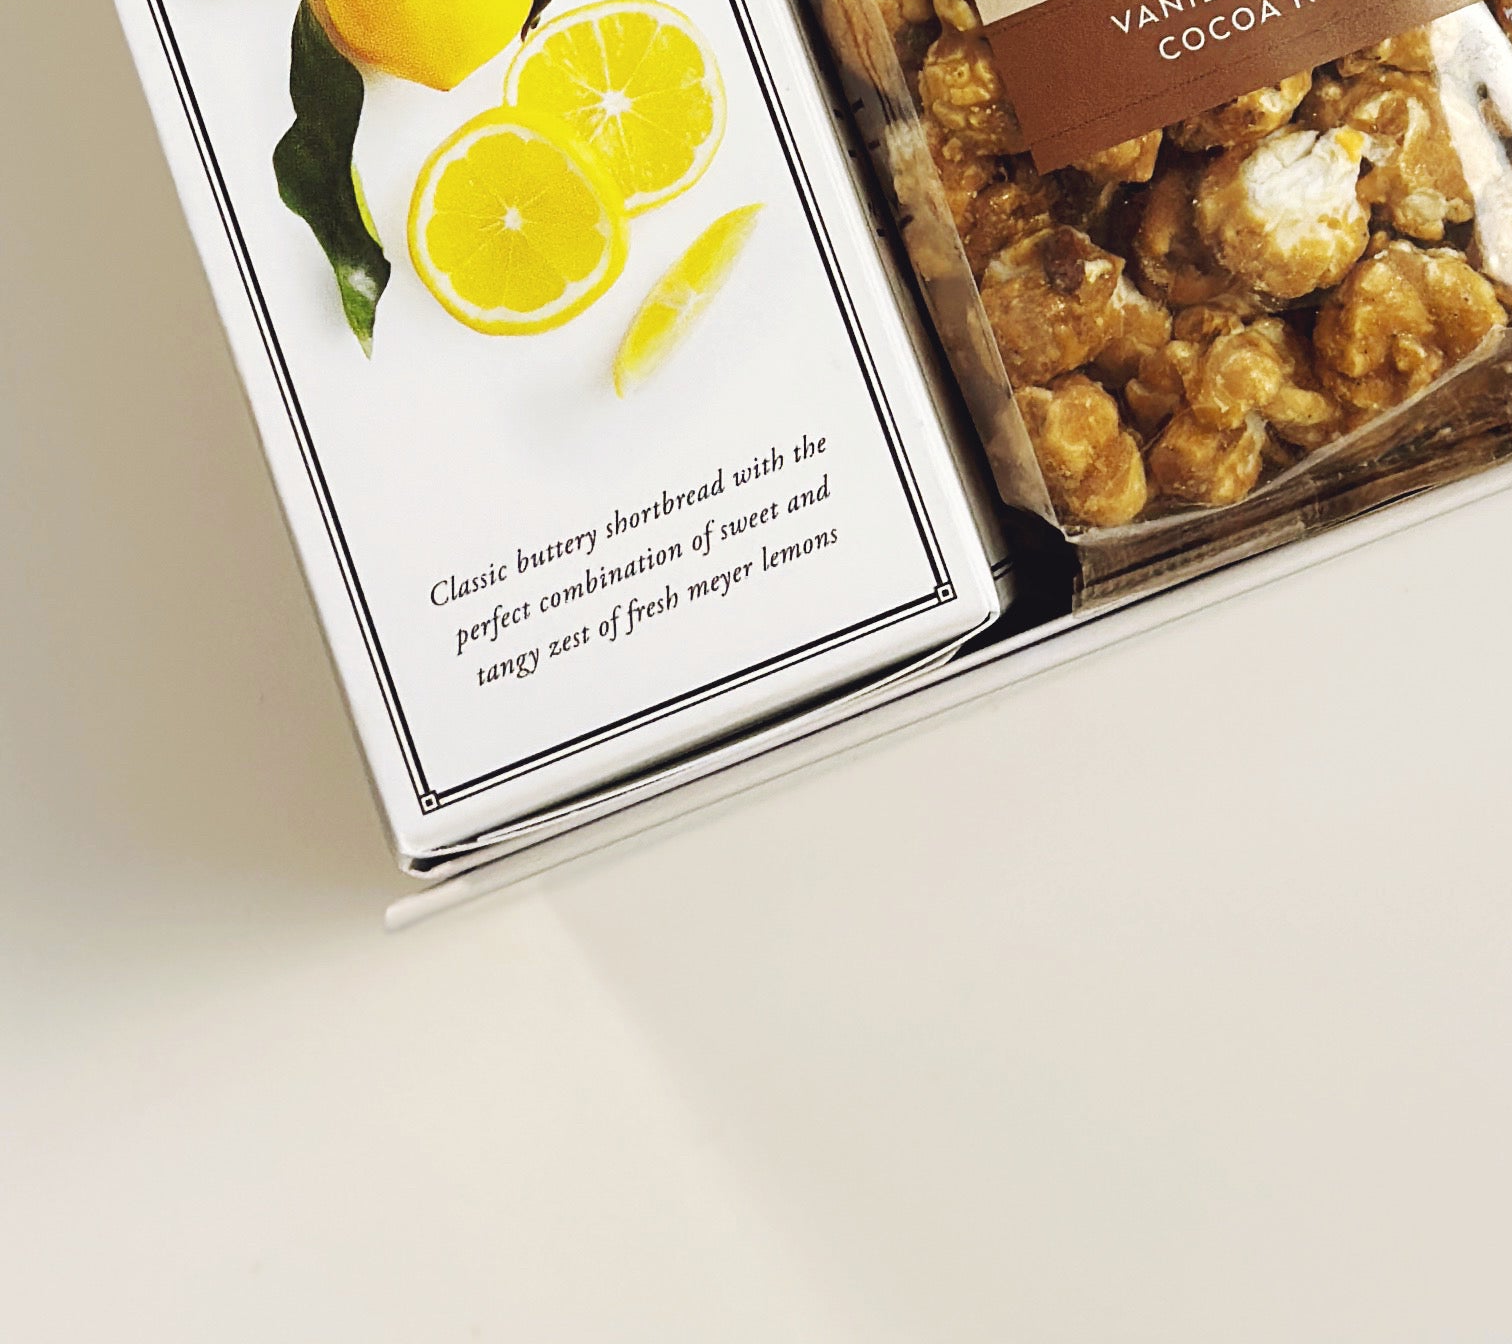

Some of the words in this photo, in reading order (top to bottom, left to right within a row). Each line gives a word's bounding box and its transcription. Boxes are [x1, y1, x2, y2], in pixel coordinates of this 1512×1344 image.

[429, 565, 508, 608] Classic
[516, 525, 598, 575] buttery
[605, 469, 726, 540] shortbread
[732, 448, 785, 488] with
[792, 433, 828, 466] the
[455, 599, 532, 657] perfect
[539, 542, 683, 615] combination
[691, 519, 717, 558] of
[719, 502, 779, 542] sweet
[786, 474, 831, 514] and
[476, 644, 540, 687] tangy
[548, 625, 591, 659] zest
[598, 608, 623, 641] of
[624, 584, 679, 635] fresh
[686, 559, 753, 602] meyer
[761, 526, 839, 572] lemons
